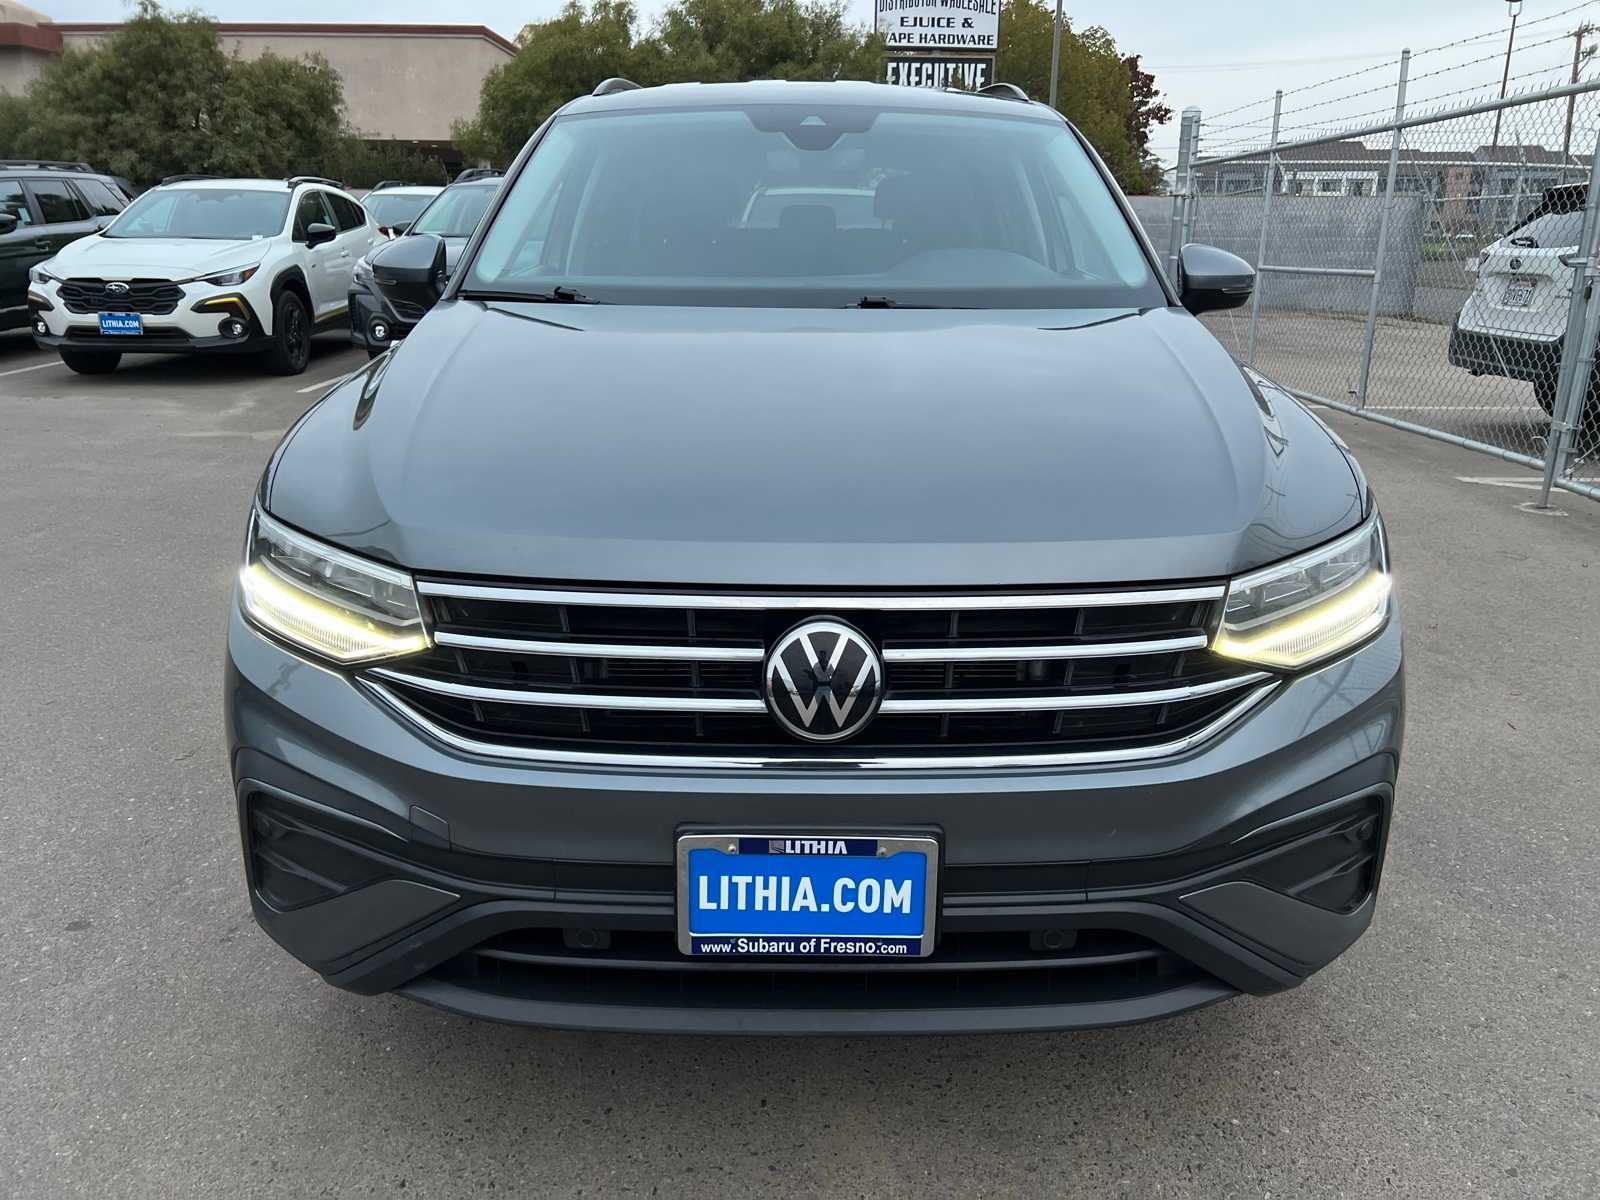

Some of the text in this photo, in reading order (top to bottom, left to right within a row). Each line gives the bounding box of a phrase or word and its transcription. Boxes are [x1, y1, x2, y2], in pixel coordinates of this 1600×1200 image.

[900, 16, 975, 28] EJUICE &
[886, 32, 995, 46] APE HARDWARE
[102, 320, 139, 328] LITHIA.COM
[785, 840, 848, 855] LITHIA
[698, 875, 913, 914] LITHIA.COM
[700, 938, 907, 954] www.Subaru of Fresno.com
